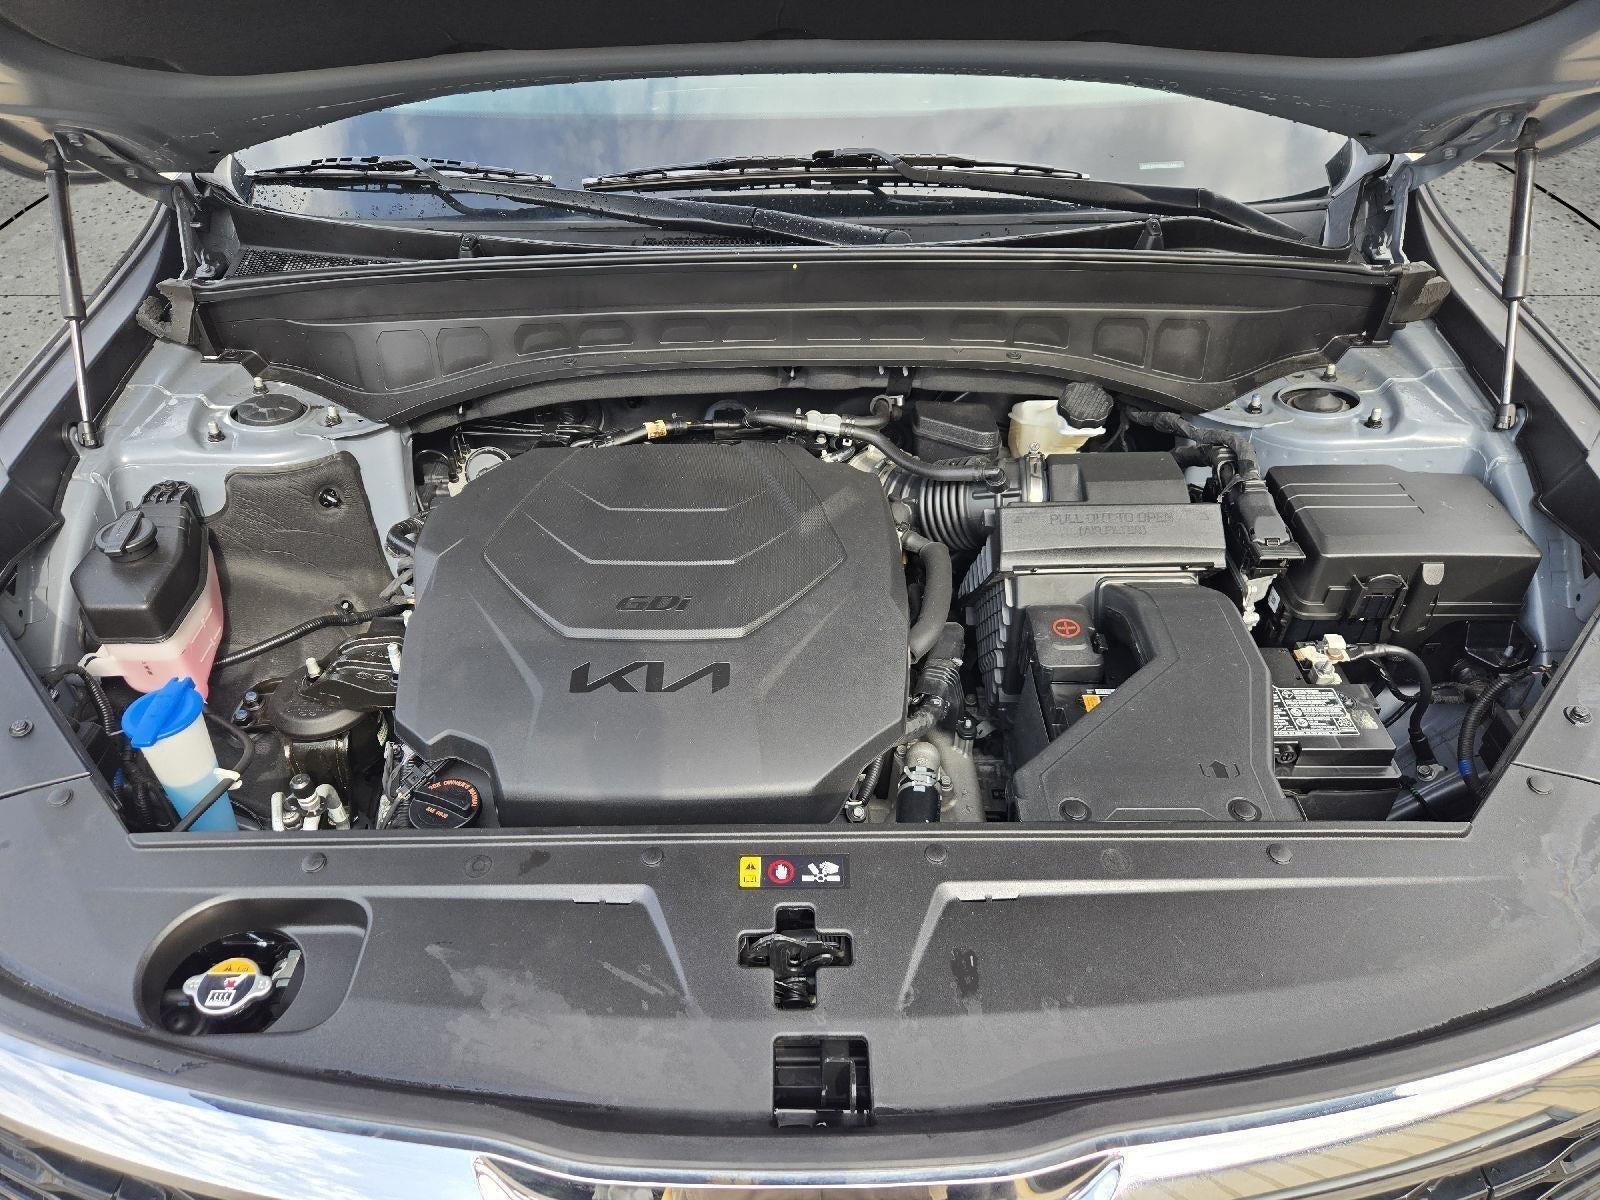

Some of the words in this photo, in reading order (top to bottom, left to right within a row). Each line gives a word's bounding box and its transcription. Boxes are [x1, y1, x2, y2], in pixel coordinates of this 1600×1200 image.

[1049, 513, 1083, 525] PULL
[1115, 512, 1134, 523] TO
[1136, 511, 1174, 523] OPEN
[569, 660, 730, 694] KIA
